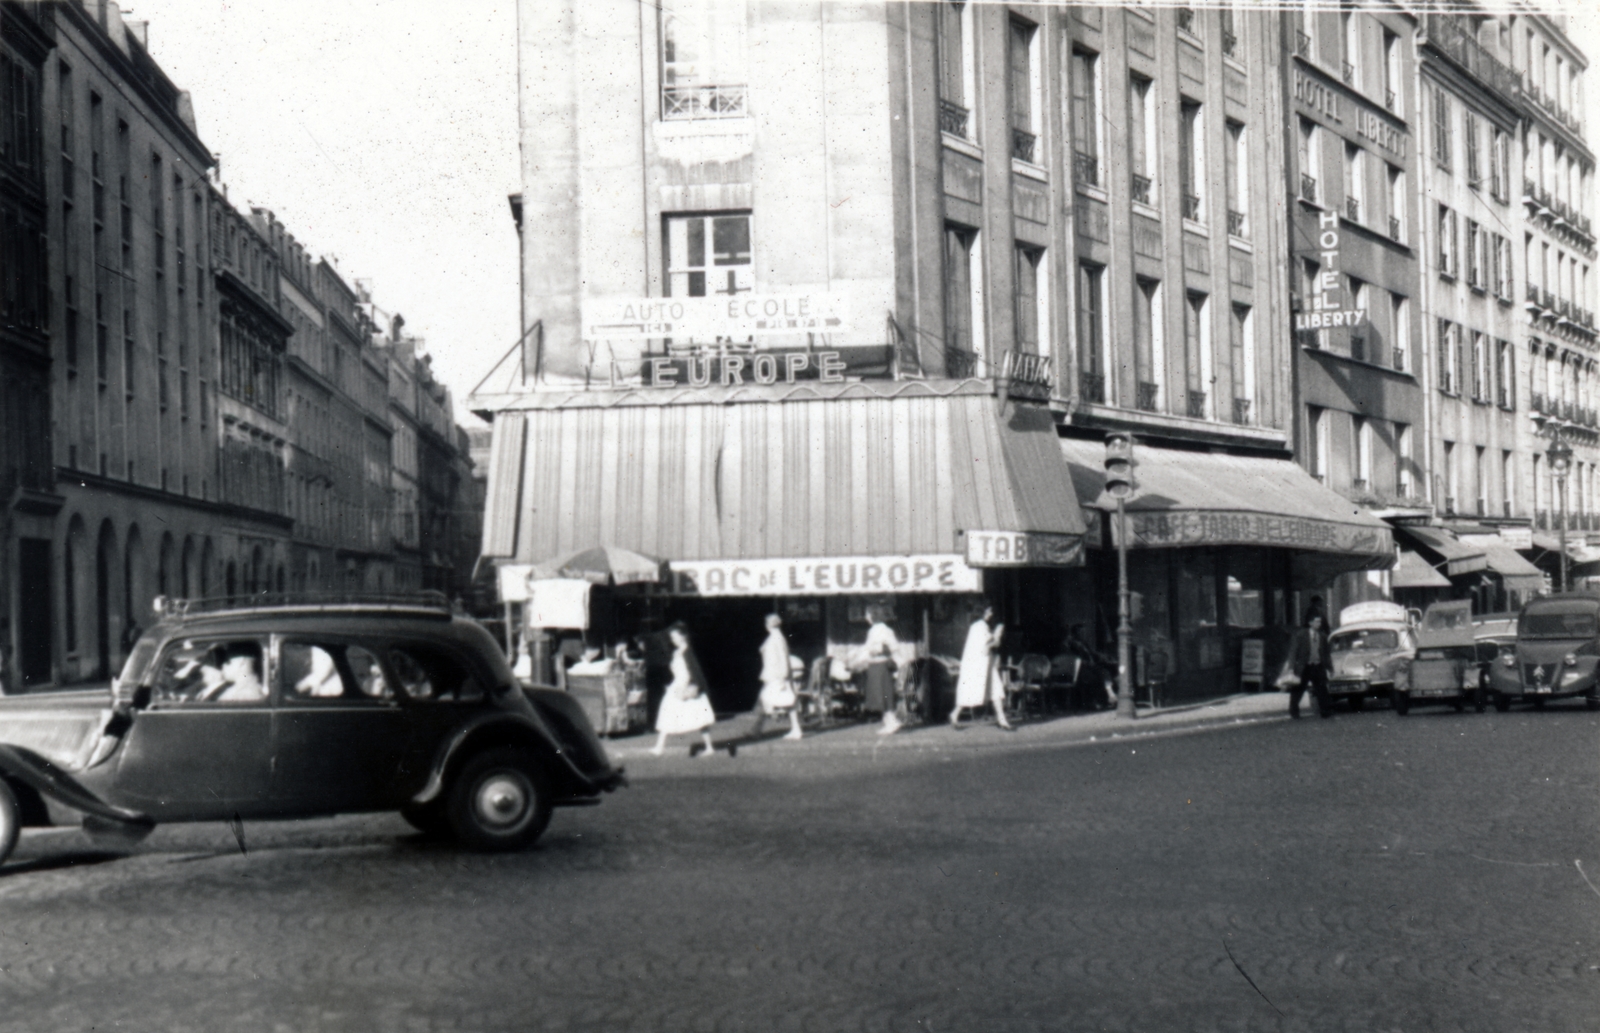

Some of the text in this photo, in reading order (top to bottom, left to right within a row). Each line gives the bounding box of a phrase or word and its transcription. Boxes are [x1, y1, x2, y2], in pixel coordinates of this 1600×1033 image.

[1293, 69, 1406, 160] HOTEL LIBERTY
[1319, 210, 1340, 310] HOTEL
[622, 301, 685, 321] AUTO
[1295, 310, 1364, 330] LIBERTY
[788, 561, 955, 590] L'EUROPE
